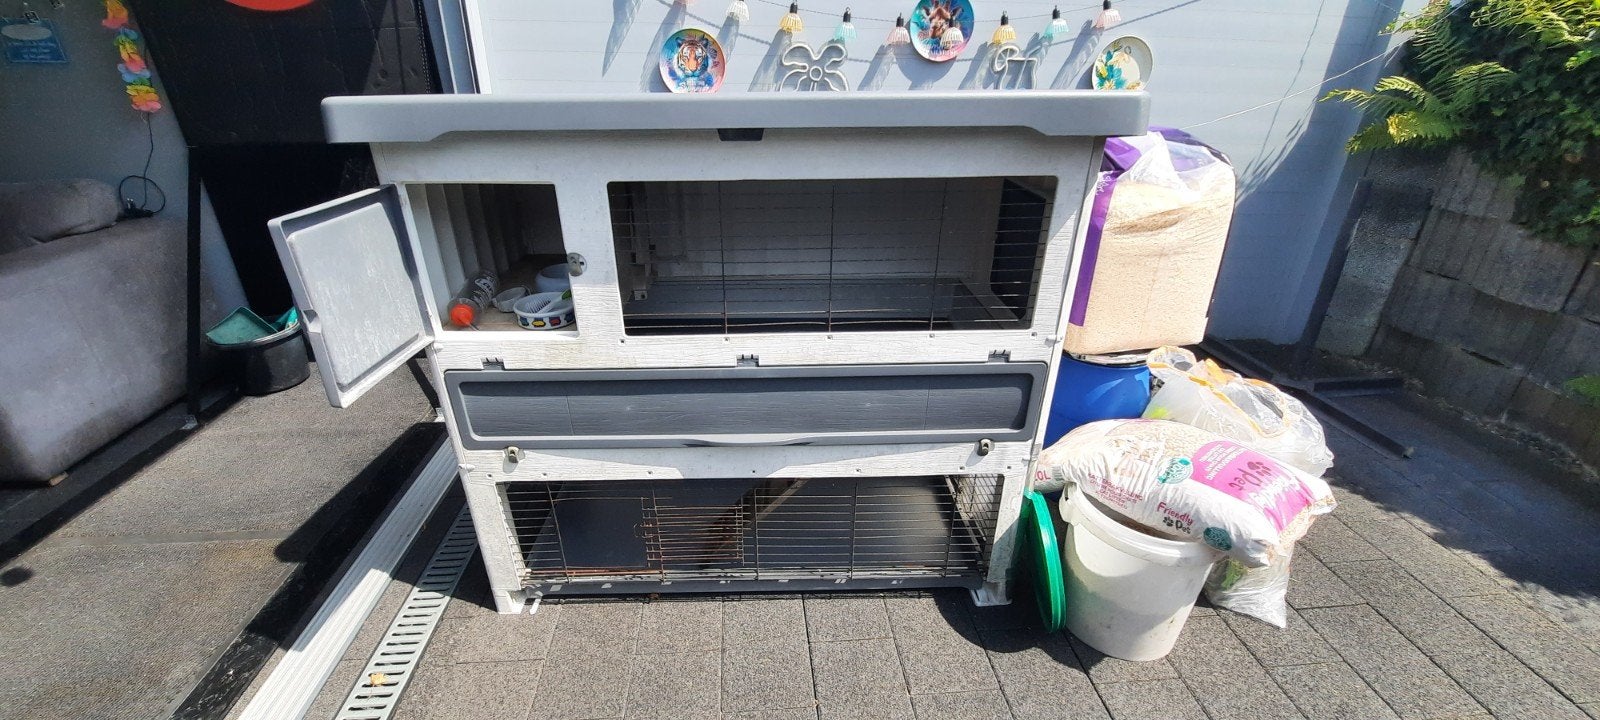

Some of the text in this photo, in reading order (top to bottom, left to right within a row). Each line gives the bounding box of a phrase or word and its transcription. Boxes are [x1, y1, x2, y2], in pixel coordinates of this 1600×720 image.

[1228, 468, 1263, 491] Pet
[1157, 502, 1194, 526] Friendly
[1175, 520, 1191, 534] Pet
